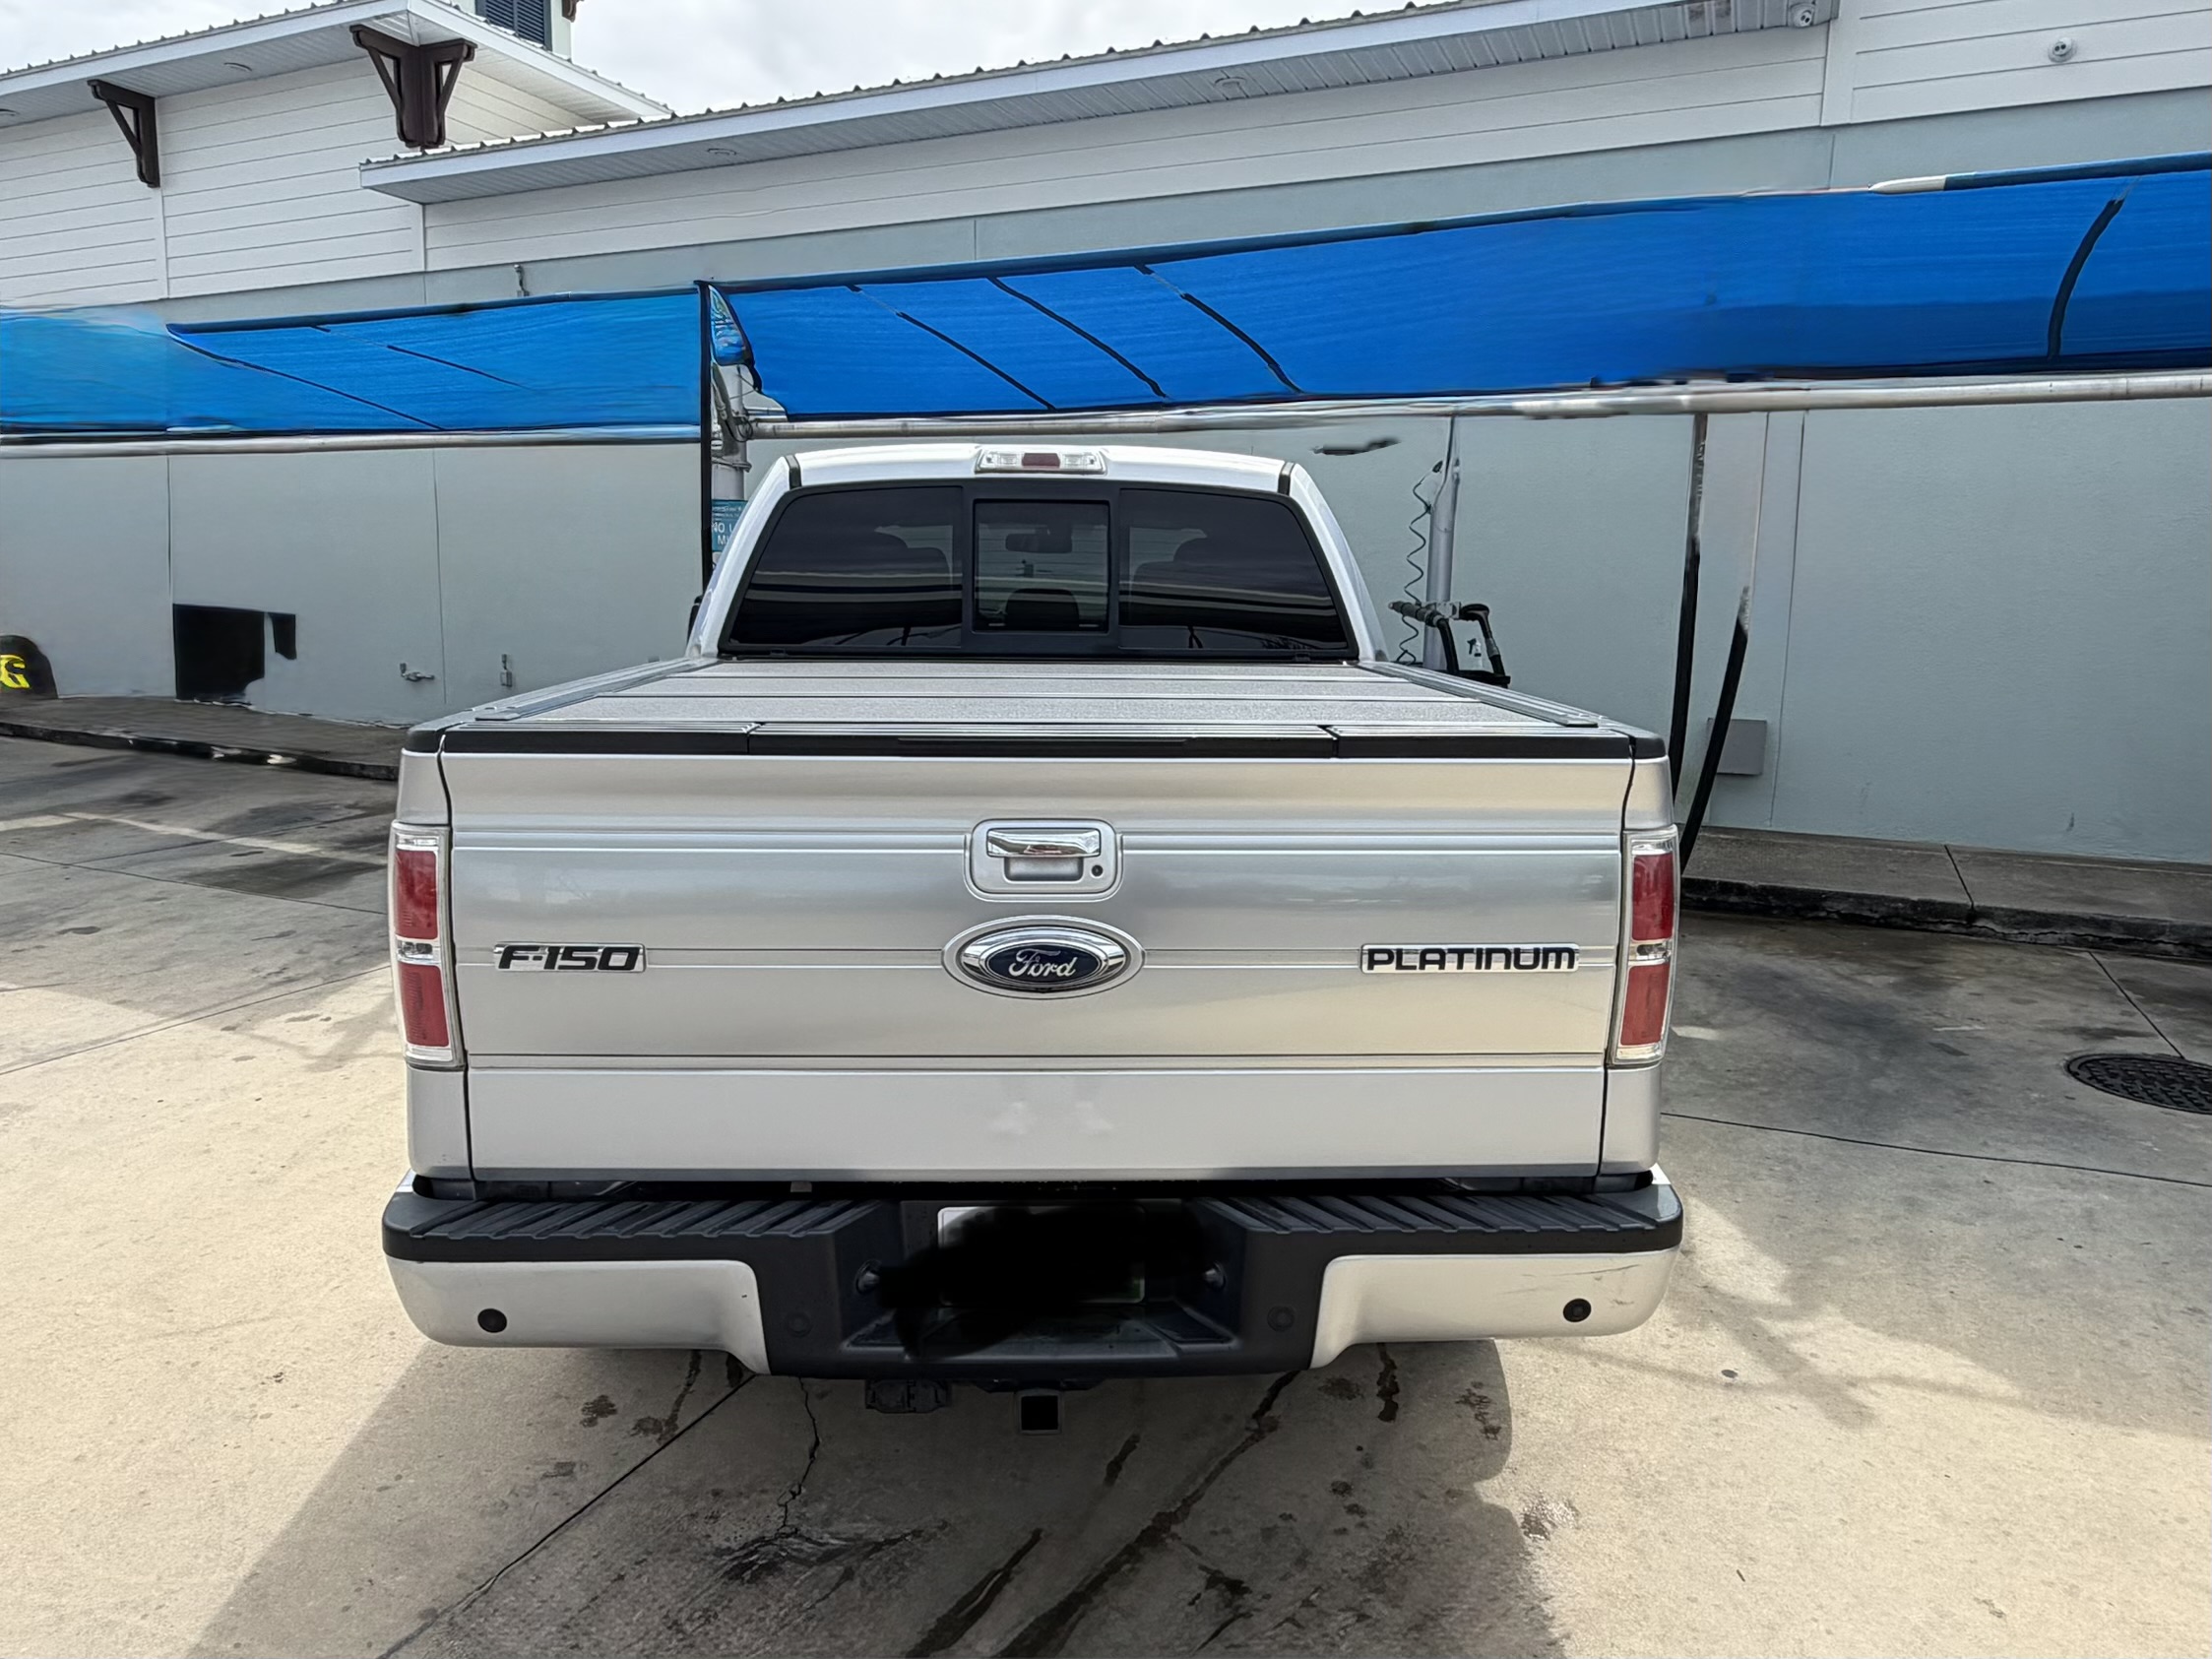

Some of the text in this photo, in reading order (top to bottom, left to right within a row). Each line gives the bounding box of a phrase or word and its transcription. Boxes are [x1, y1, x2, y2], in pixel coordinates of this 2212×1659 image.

[497, 945, 641, 971] F-150
[1008, 948, 1079, 978] Ford
[1366, 947, 1576, 971] PLATINUM
